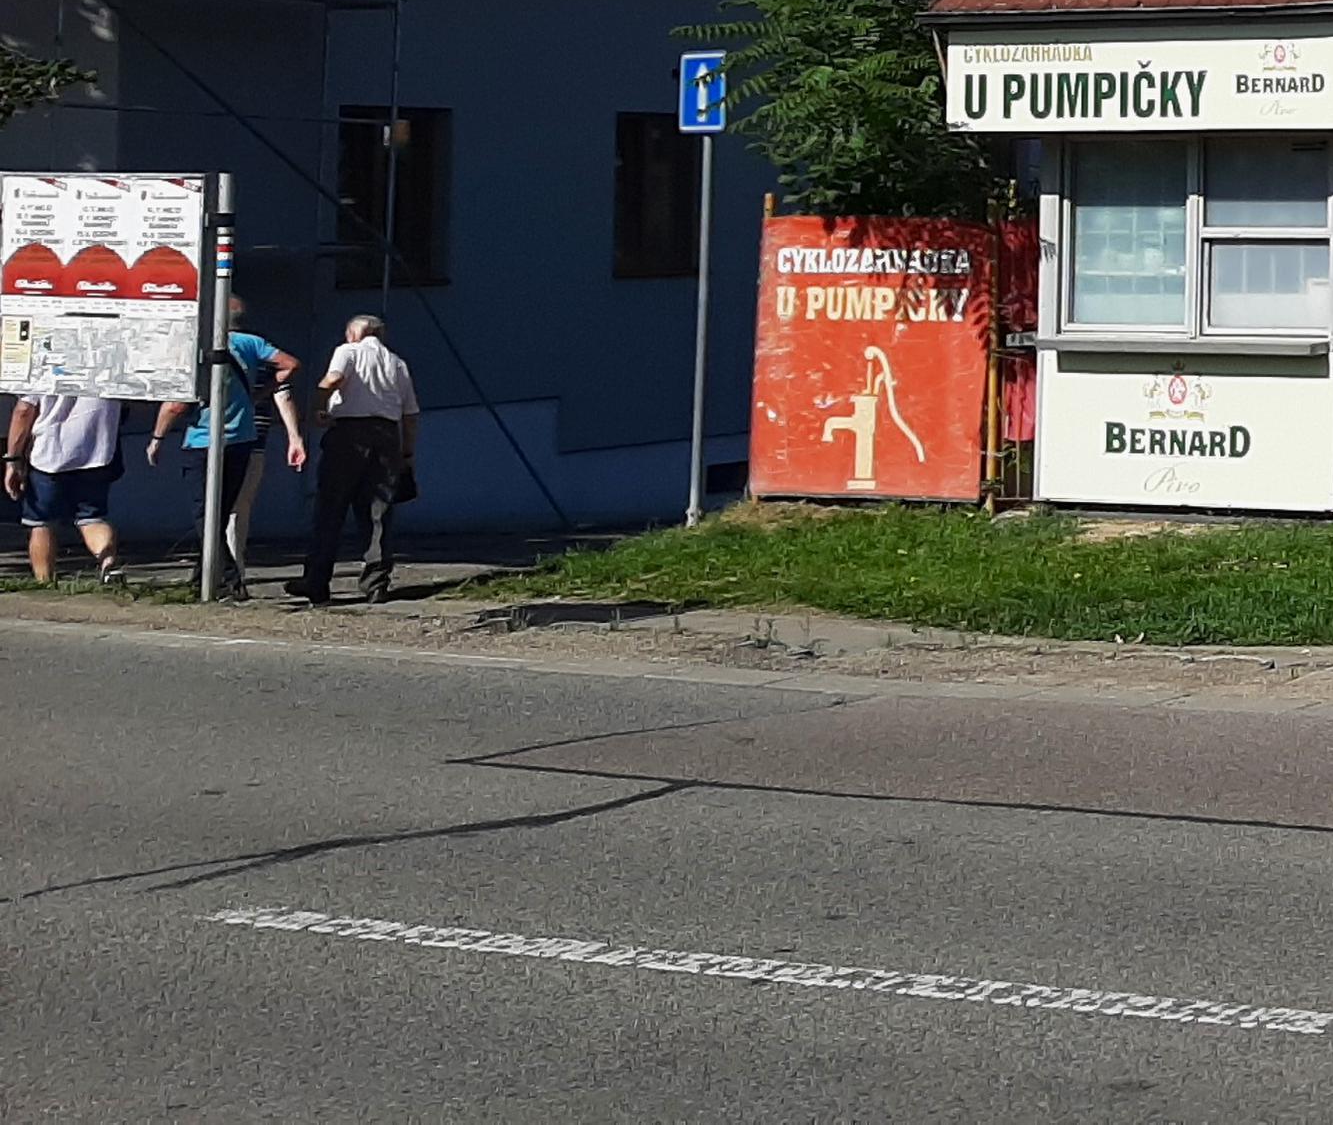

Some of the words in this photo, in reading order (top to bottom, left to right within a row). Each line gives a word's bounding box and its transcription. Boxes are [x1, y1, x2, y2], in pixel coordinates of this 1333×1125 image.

[964, 73, 988, 119] U
[1003, 59, 1208, 119] PUMPIČKY
[1235, 73, 1325, 94] BERNARD
[776, 286, 797, 320] U
[1104, 421, 1251, 459] BERNARD
